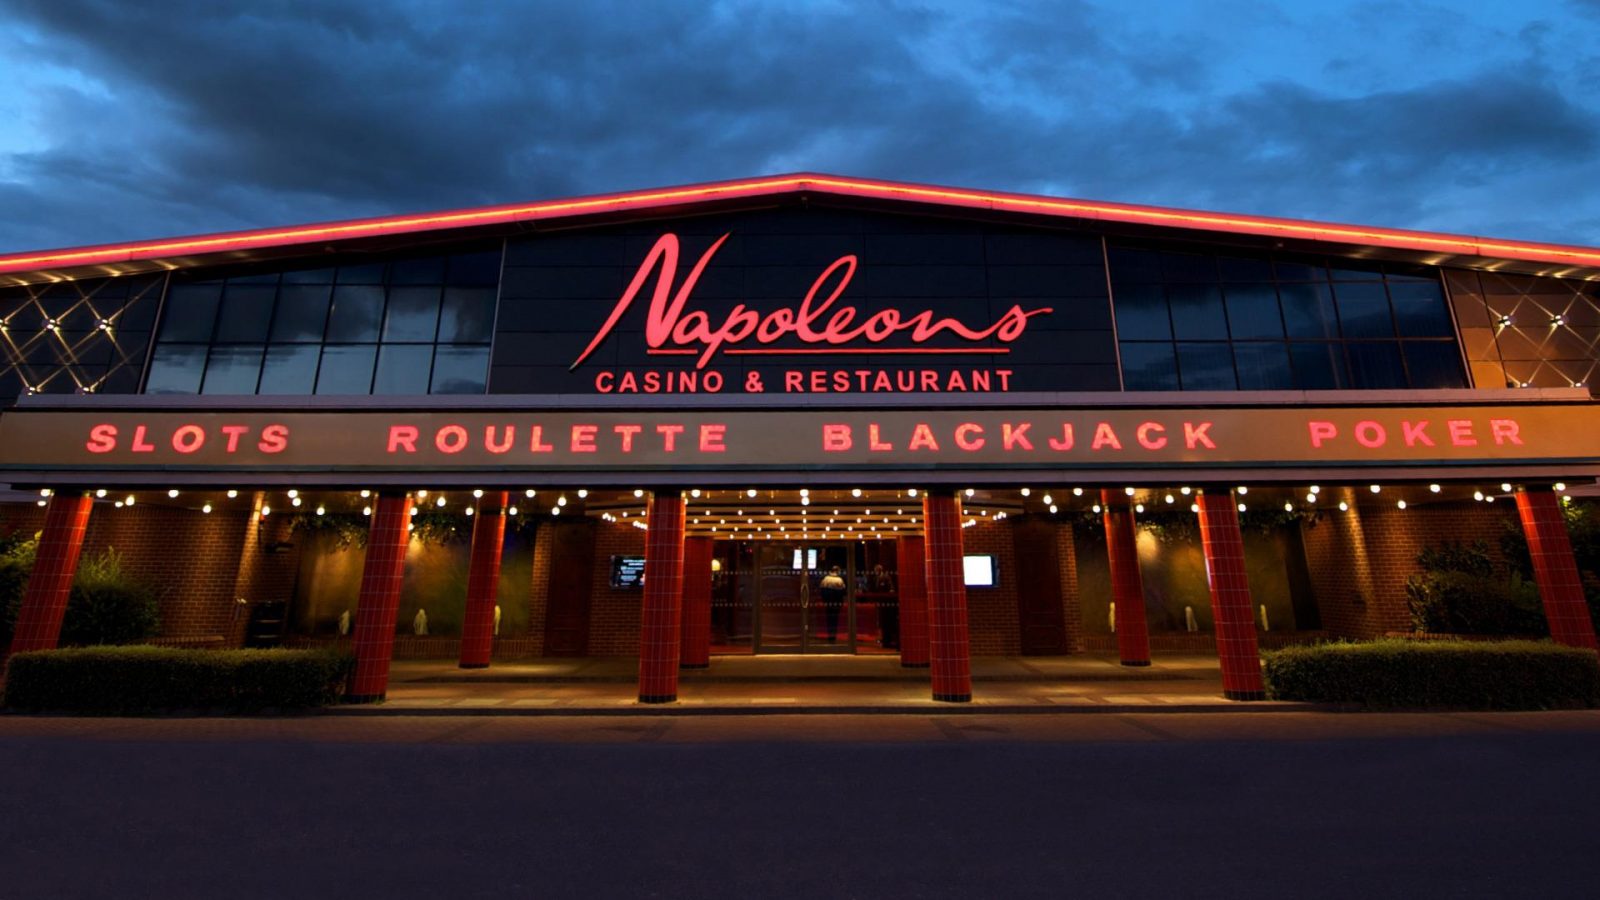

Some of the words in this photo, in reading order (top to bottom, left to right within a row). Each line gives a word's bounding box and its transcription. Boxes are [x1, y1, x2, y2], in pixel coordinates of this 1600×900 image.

[570, 231, 1054, 370] Napoleons
[595, 370, 723, 393] CASINO
[744, 370, 764, 393] &
[785, 369, 1013, 393] RESTAURANT
[86, 423, 290, 454] SLOTS
[386, 423, 728, 454] ROULETTE
[822, 420, 1218, 452] BLACKJACK
[1308, 419, 1524, 448] POKER
